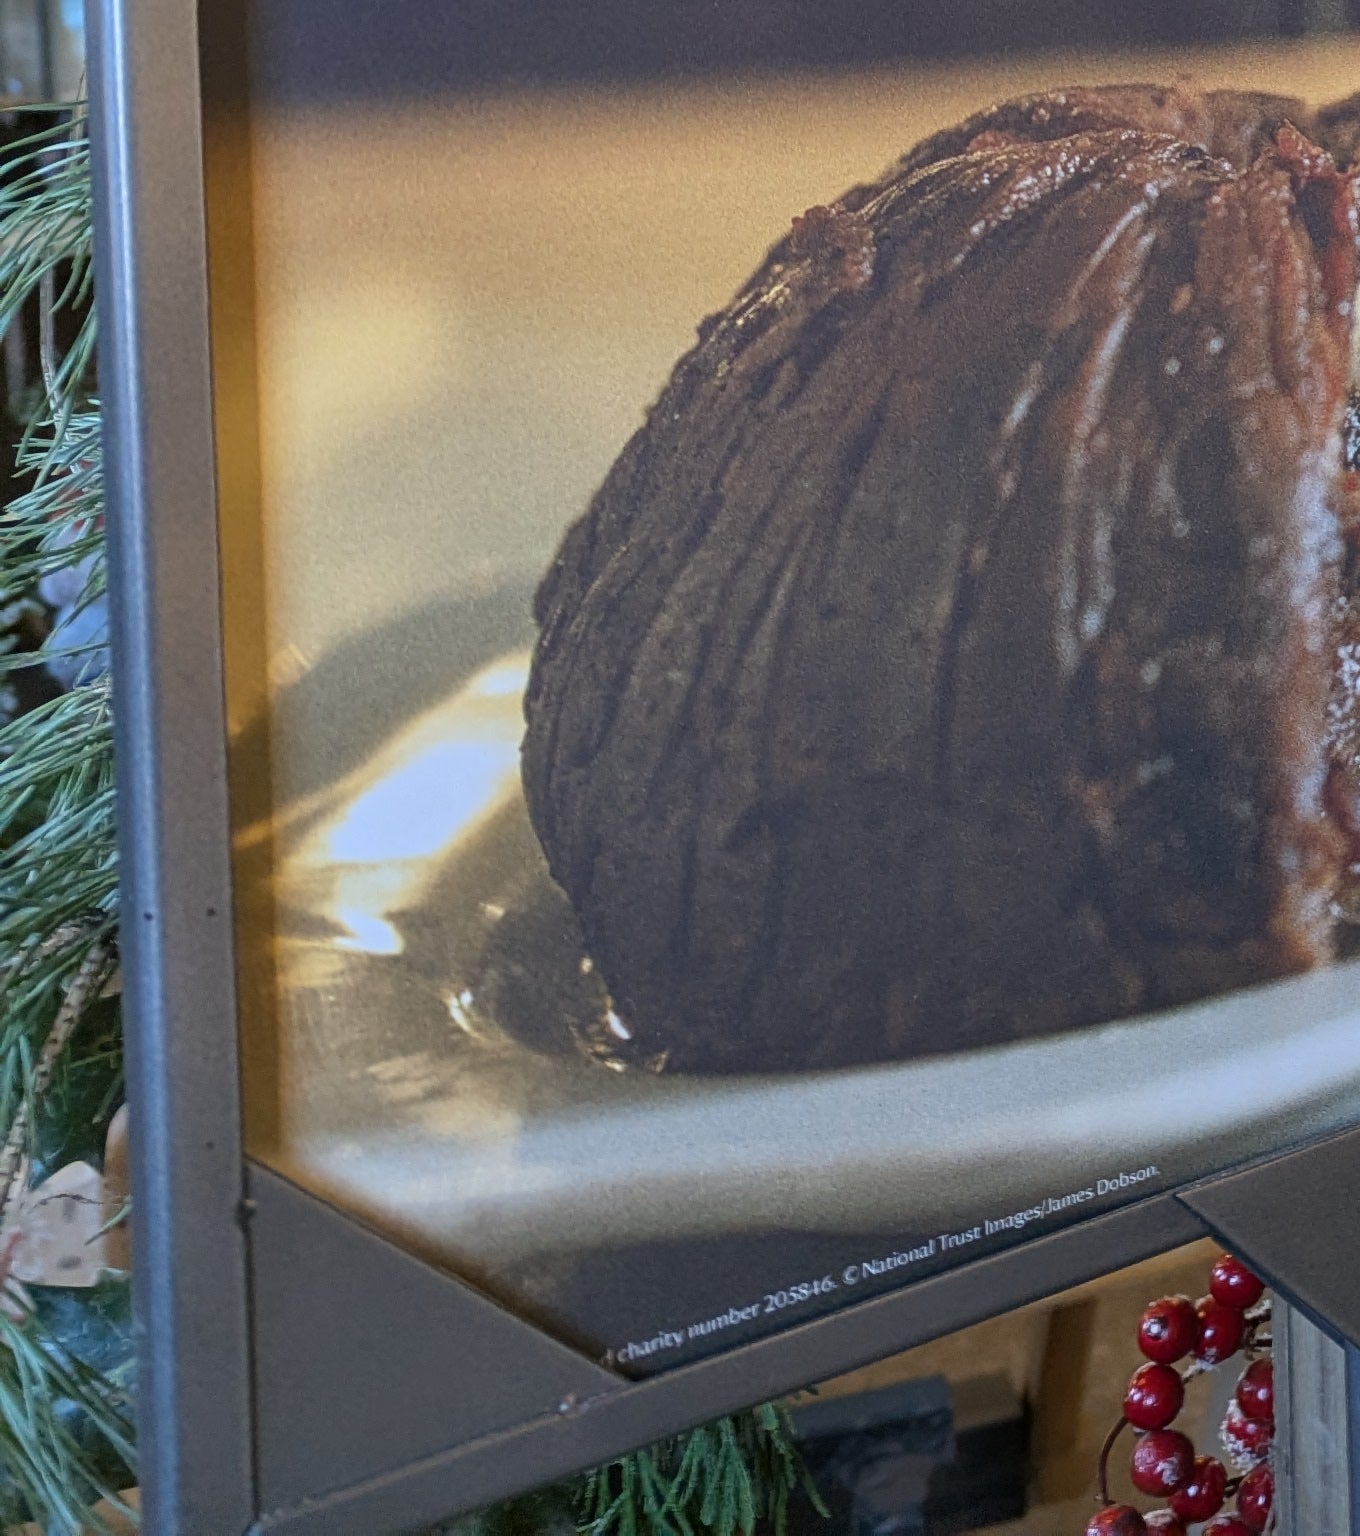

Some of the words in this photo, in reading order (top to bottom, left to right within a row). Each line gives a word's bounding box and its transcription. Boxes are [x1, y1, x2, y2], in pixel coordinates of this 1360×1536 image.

[616, 1330, 685, 1364] charity
[687, 1303, 760, 1339] number
[862, 1239, 936, 1278] National
[936, 1226, 982, 1251] Trust
